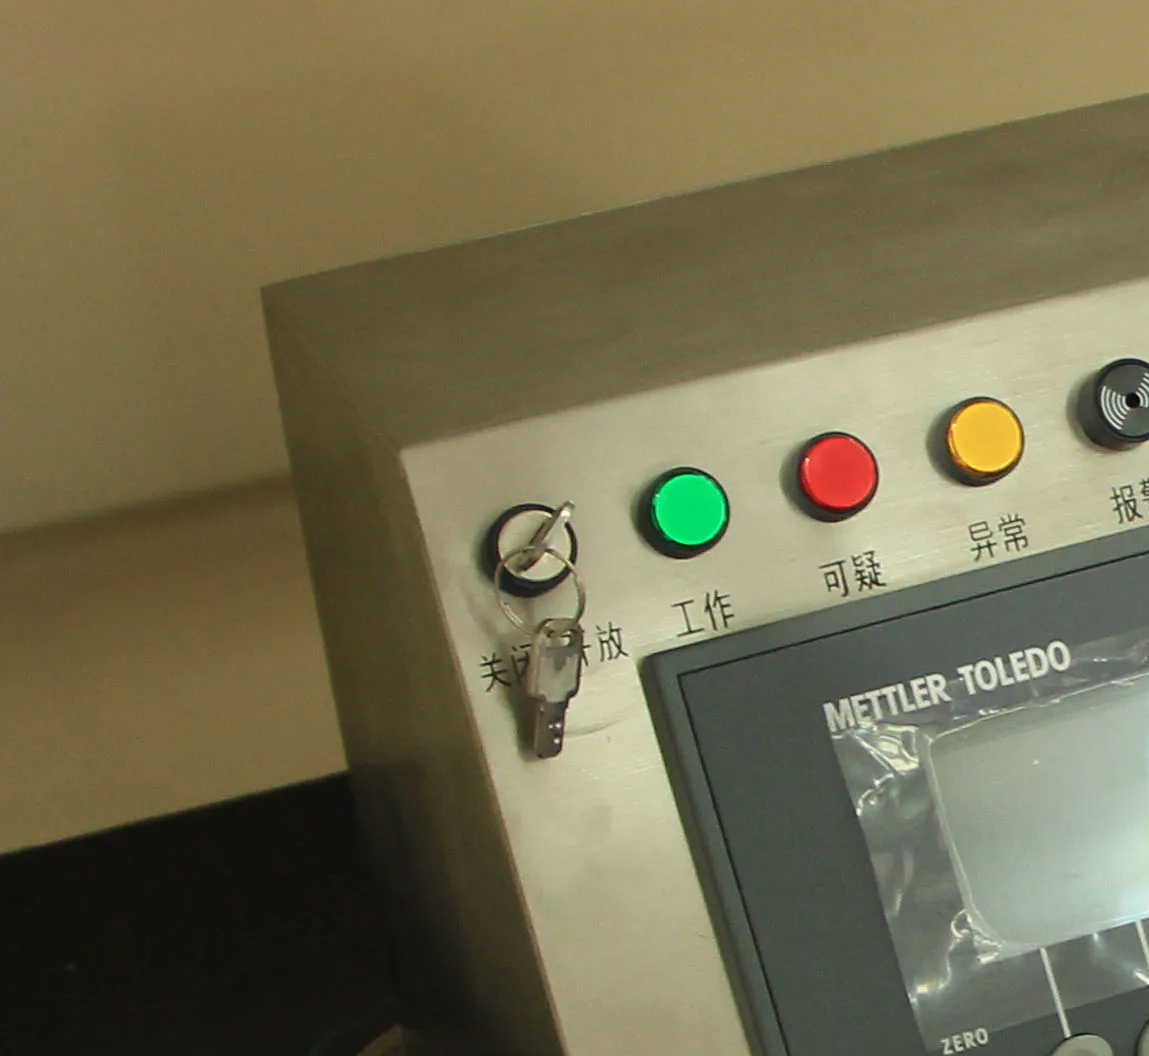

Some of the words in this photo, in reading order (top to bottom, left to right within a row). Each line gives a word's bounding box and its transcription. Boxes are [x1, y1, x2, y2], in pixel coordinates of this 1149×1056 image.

[967, 512, 1029, 562] 异常
[818, 550, 887, 598] 可疑
[670, 589, 735, 638] 工作
[823, 672, 952, 732] METTLER
[956, 640, 1072, 696] TOLEDO
[940, 1027, 990, 1055] ZERO
